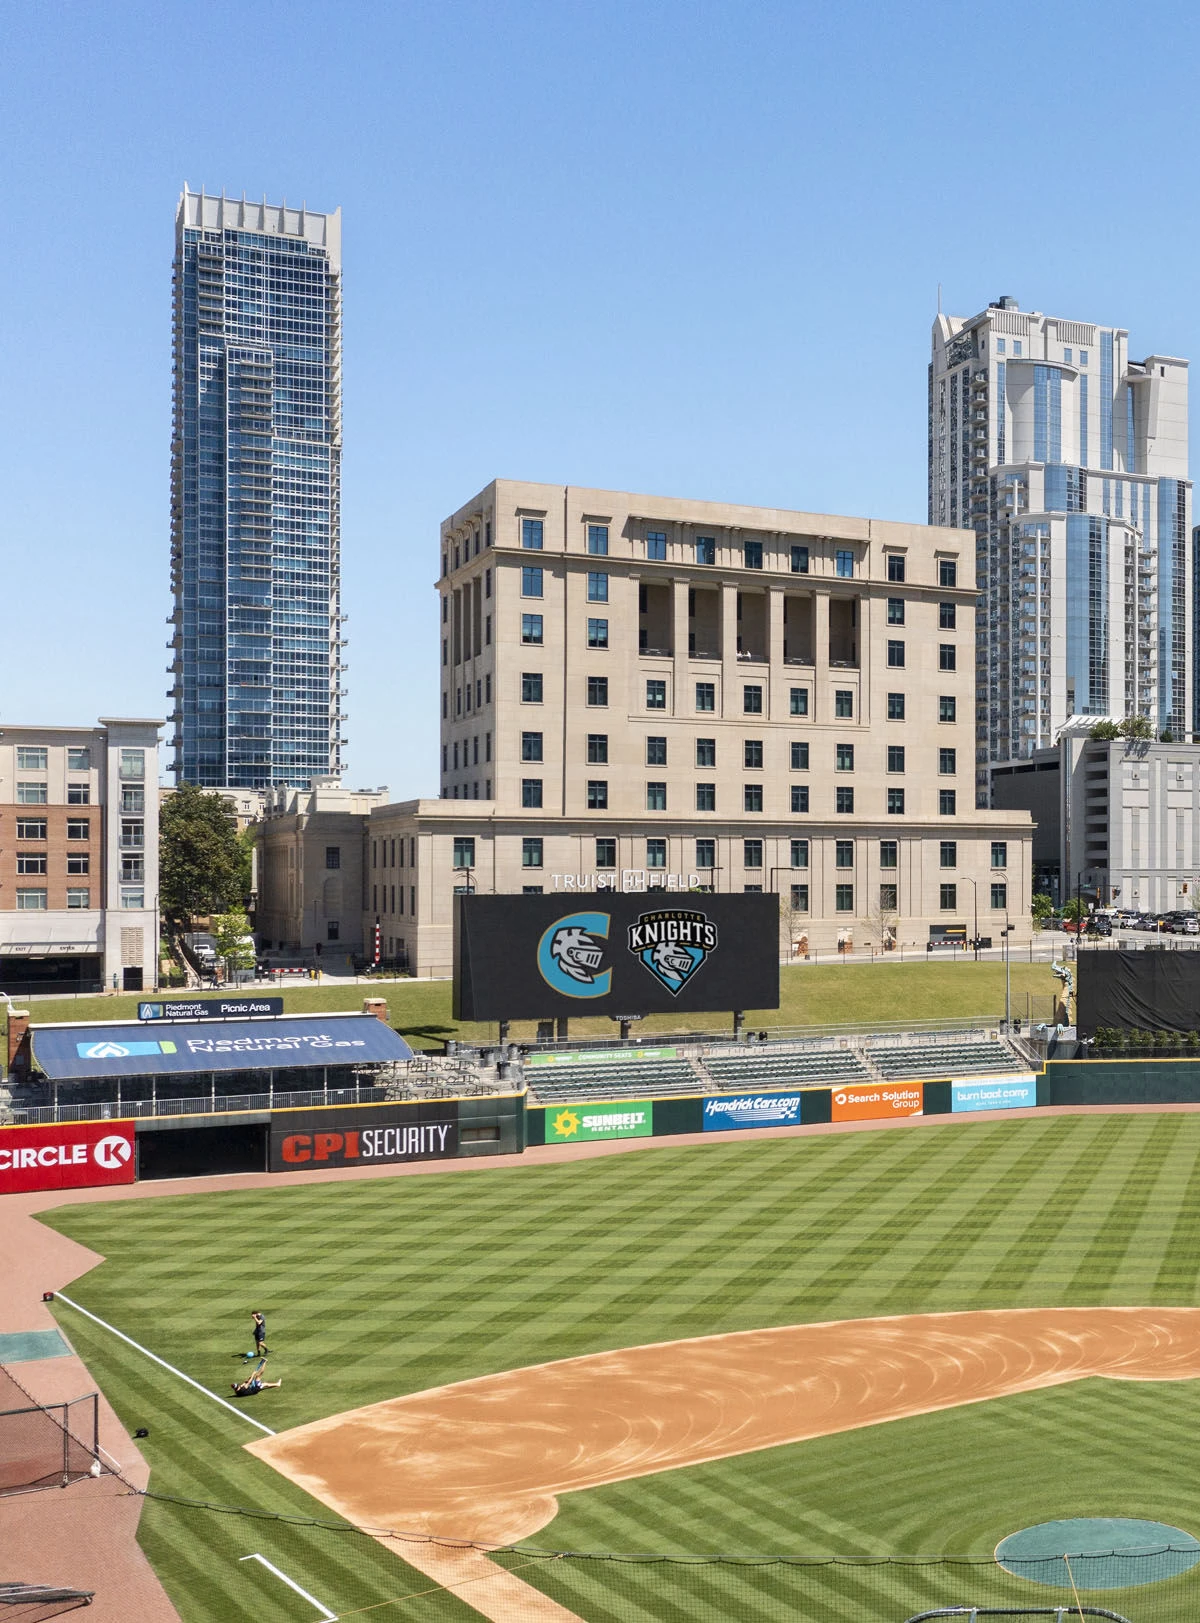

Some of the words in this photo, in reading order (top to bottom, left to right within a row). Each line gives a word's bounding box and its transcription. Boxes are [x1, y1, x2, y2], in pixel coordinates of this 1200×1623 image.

[551, 873, 617, 889] TRUIST
[650, 873, 701, 888] FIELD
[643, 911, 702, 922] CHARLOTTE
[630, 919, 715, 949] KNIGHTS
[221, 1004, 248, 1013] Picnic
[249, 1003, 270, 1012] Area
[186, 1034, 333, 1047] Piedmont
[189, 1041, 301, 1053] Natural
[310, 1040, 366, 1048] Gas
[848, 1093, 880, 1103] Search
[882, 1090, 920, 1101] Solution
[957, 1091, 980, 1101] burn
[980, 1088, 1002, 1099] boot
[1003, 1088, 1028, 1099] camp
[892, 1100, 920, 1108] Group
[582, 1112, 645, 1127] SUNBELT
[281, 1131, 360, 1163] CPI
[362, 1125, 449, 1158] SECURITY
[0, 1144, 88, 1170] CIRCLE
